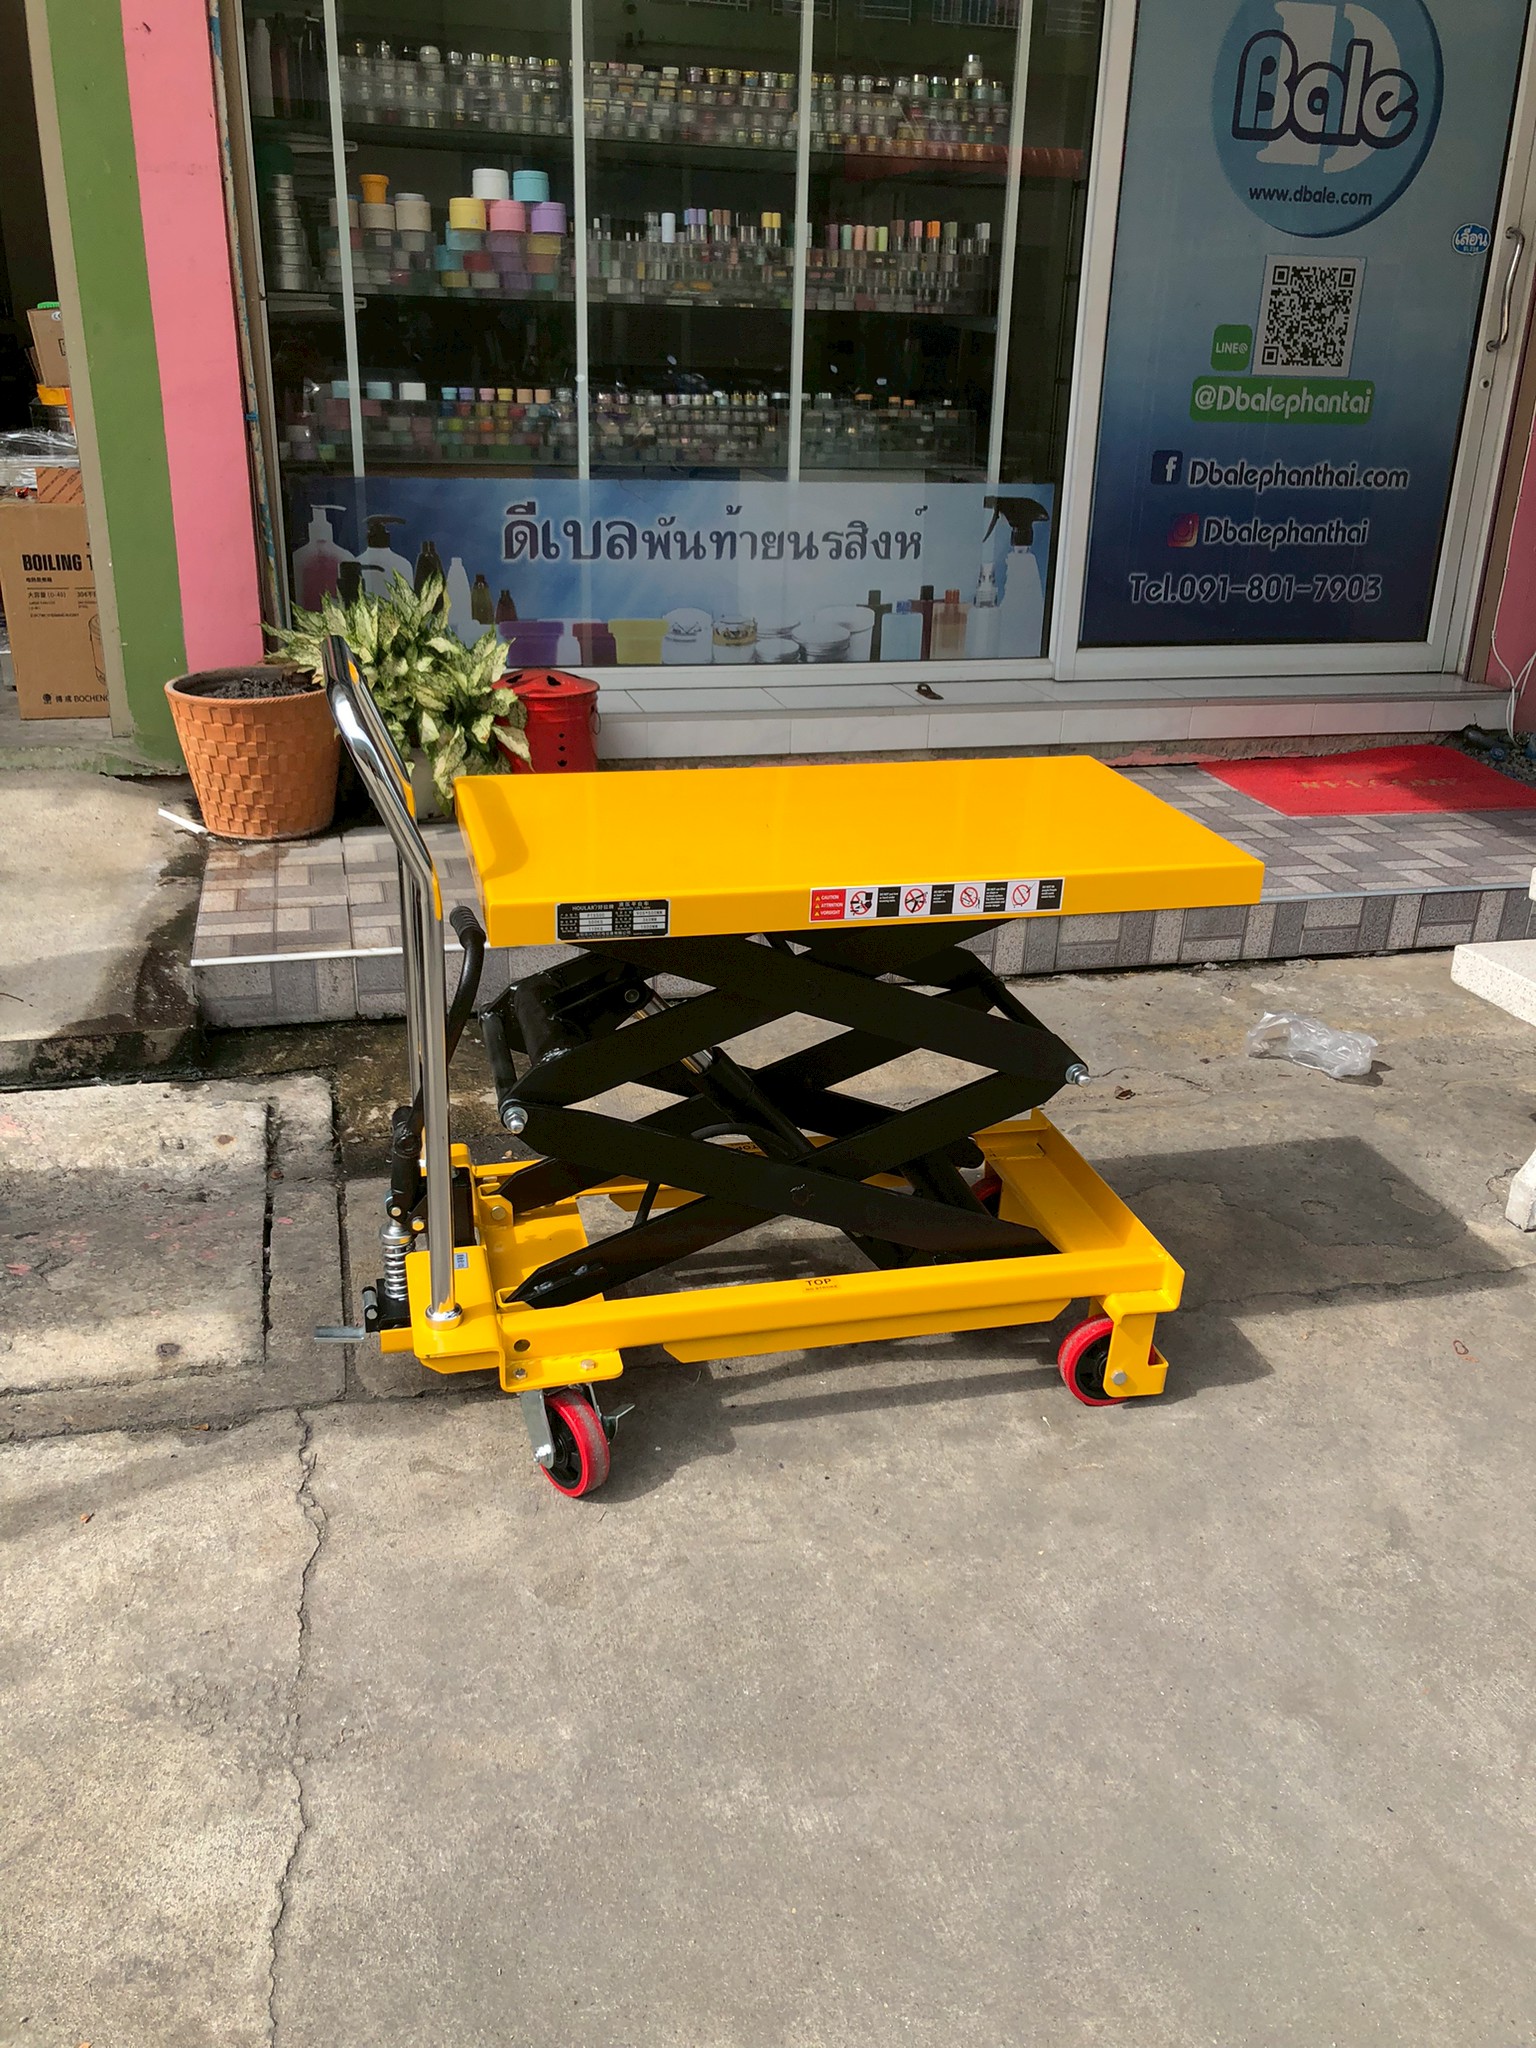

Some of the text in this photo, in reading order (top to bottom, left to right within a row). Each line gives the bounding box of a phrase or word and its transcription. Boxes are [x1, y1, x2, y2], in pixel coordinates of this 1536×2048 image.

[1232, 29, 1419, 150] Bale
[1249, 184, 1373, 206] www.dbale.com
[1194, 385, 1372, 419] @Dbalephantai
[1188, 459, 1409, 493] Dbalephanthai.com
[1203, 515, 1369, 550] Dbalephanthai
[22, 554, 82, 571] BOILING
[1129, 573, 1383, 603] Tel.091-801-7903
[805, 1278, 831, 1286] TOP
